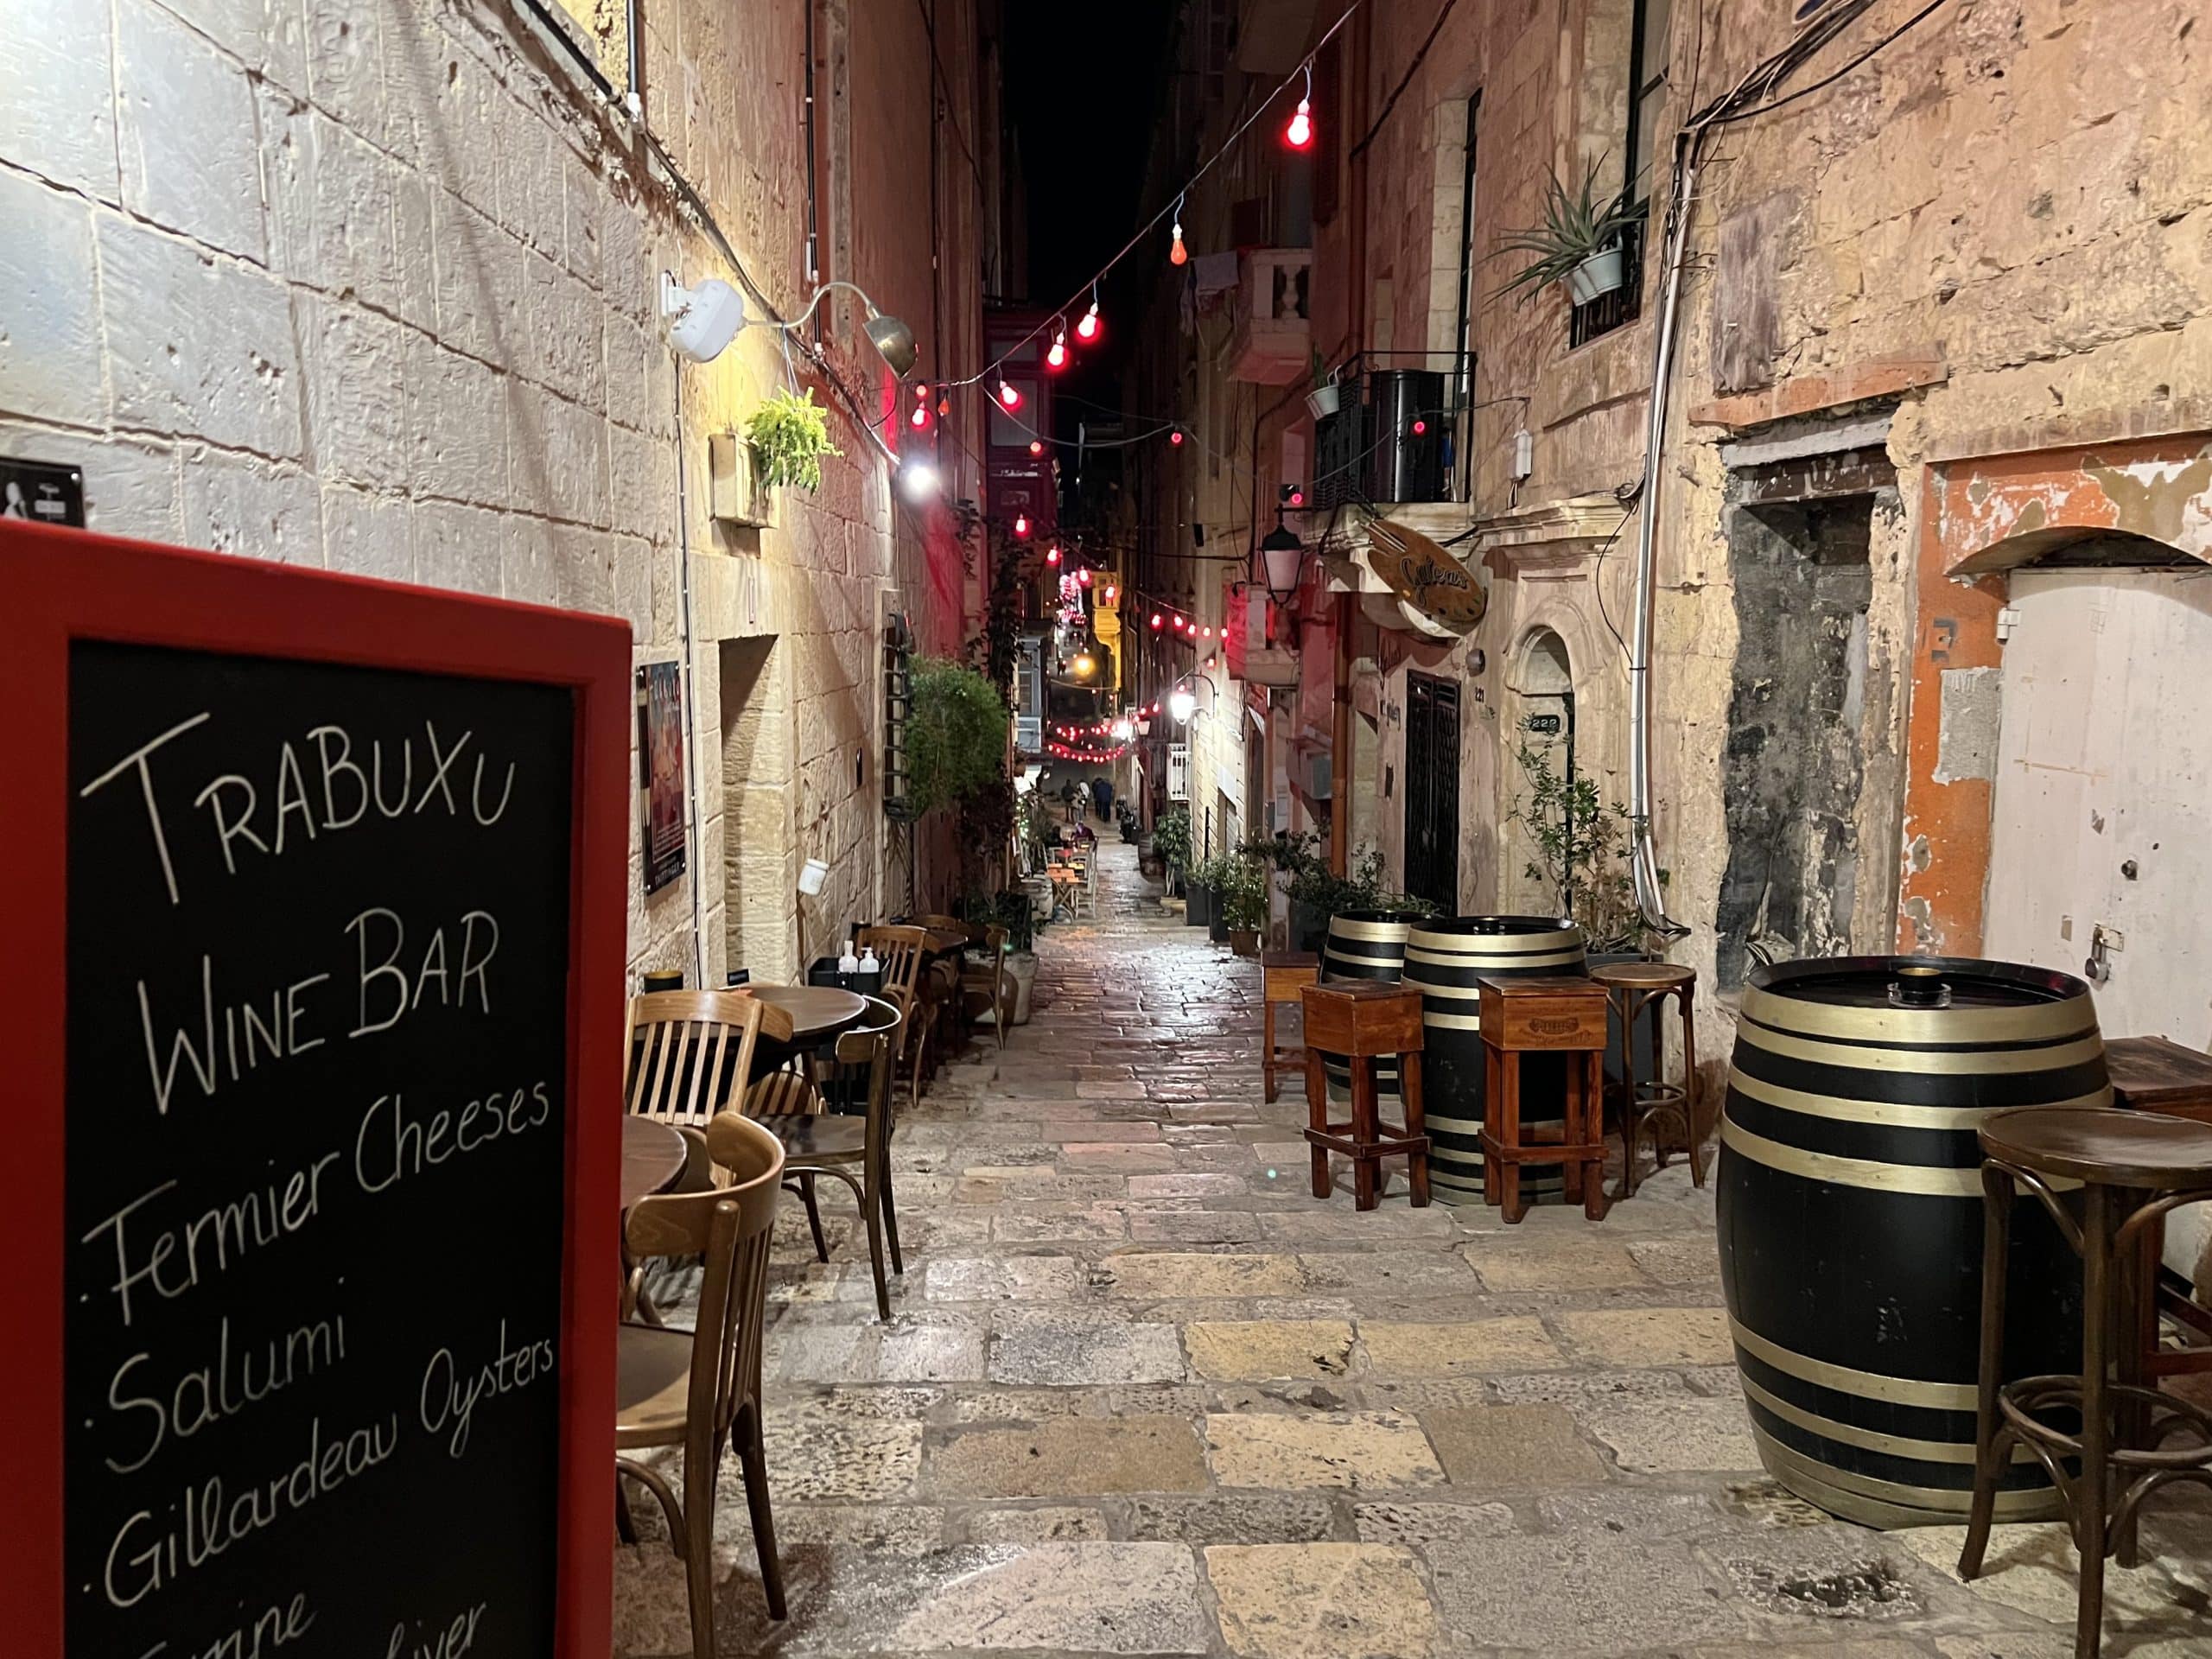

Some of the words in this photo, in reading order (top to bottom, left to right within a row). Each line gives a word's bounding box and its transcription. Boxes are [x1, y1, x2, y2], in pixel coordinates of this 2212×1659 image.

[80, 712, 516, 905] TRABUXU
[138, 954, 330, 1115] WINE
[344, 907, 499, 1039] BAR
[81, 1152, 340, 1325] Fermier
[355, 1081, 550, 1192] Cheeses
[105, 1414, 397, 1608] Gillardeau
[420, 1318, 554, 1459] Oysters
[106, 1275, 346, 1472] Salumi
